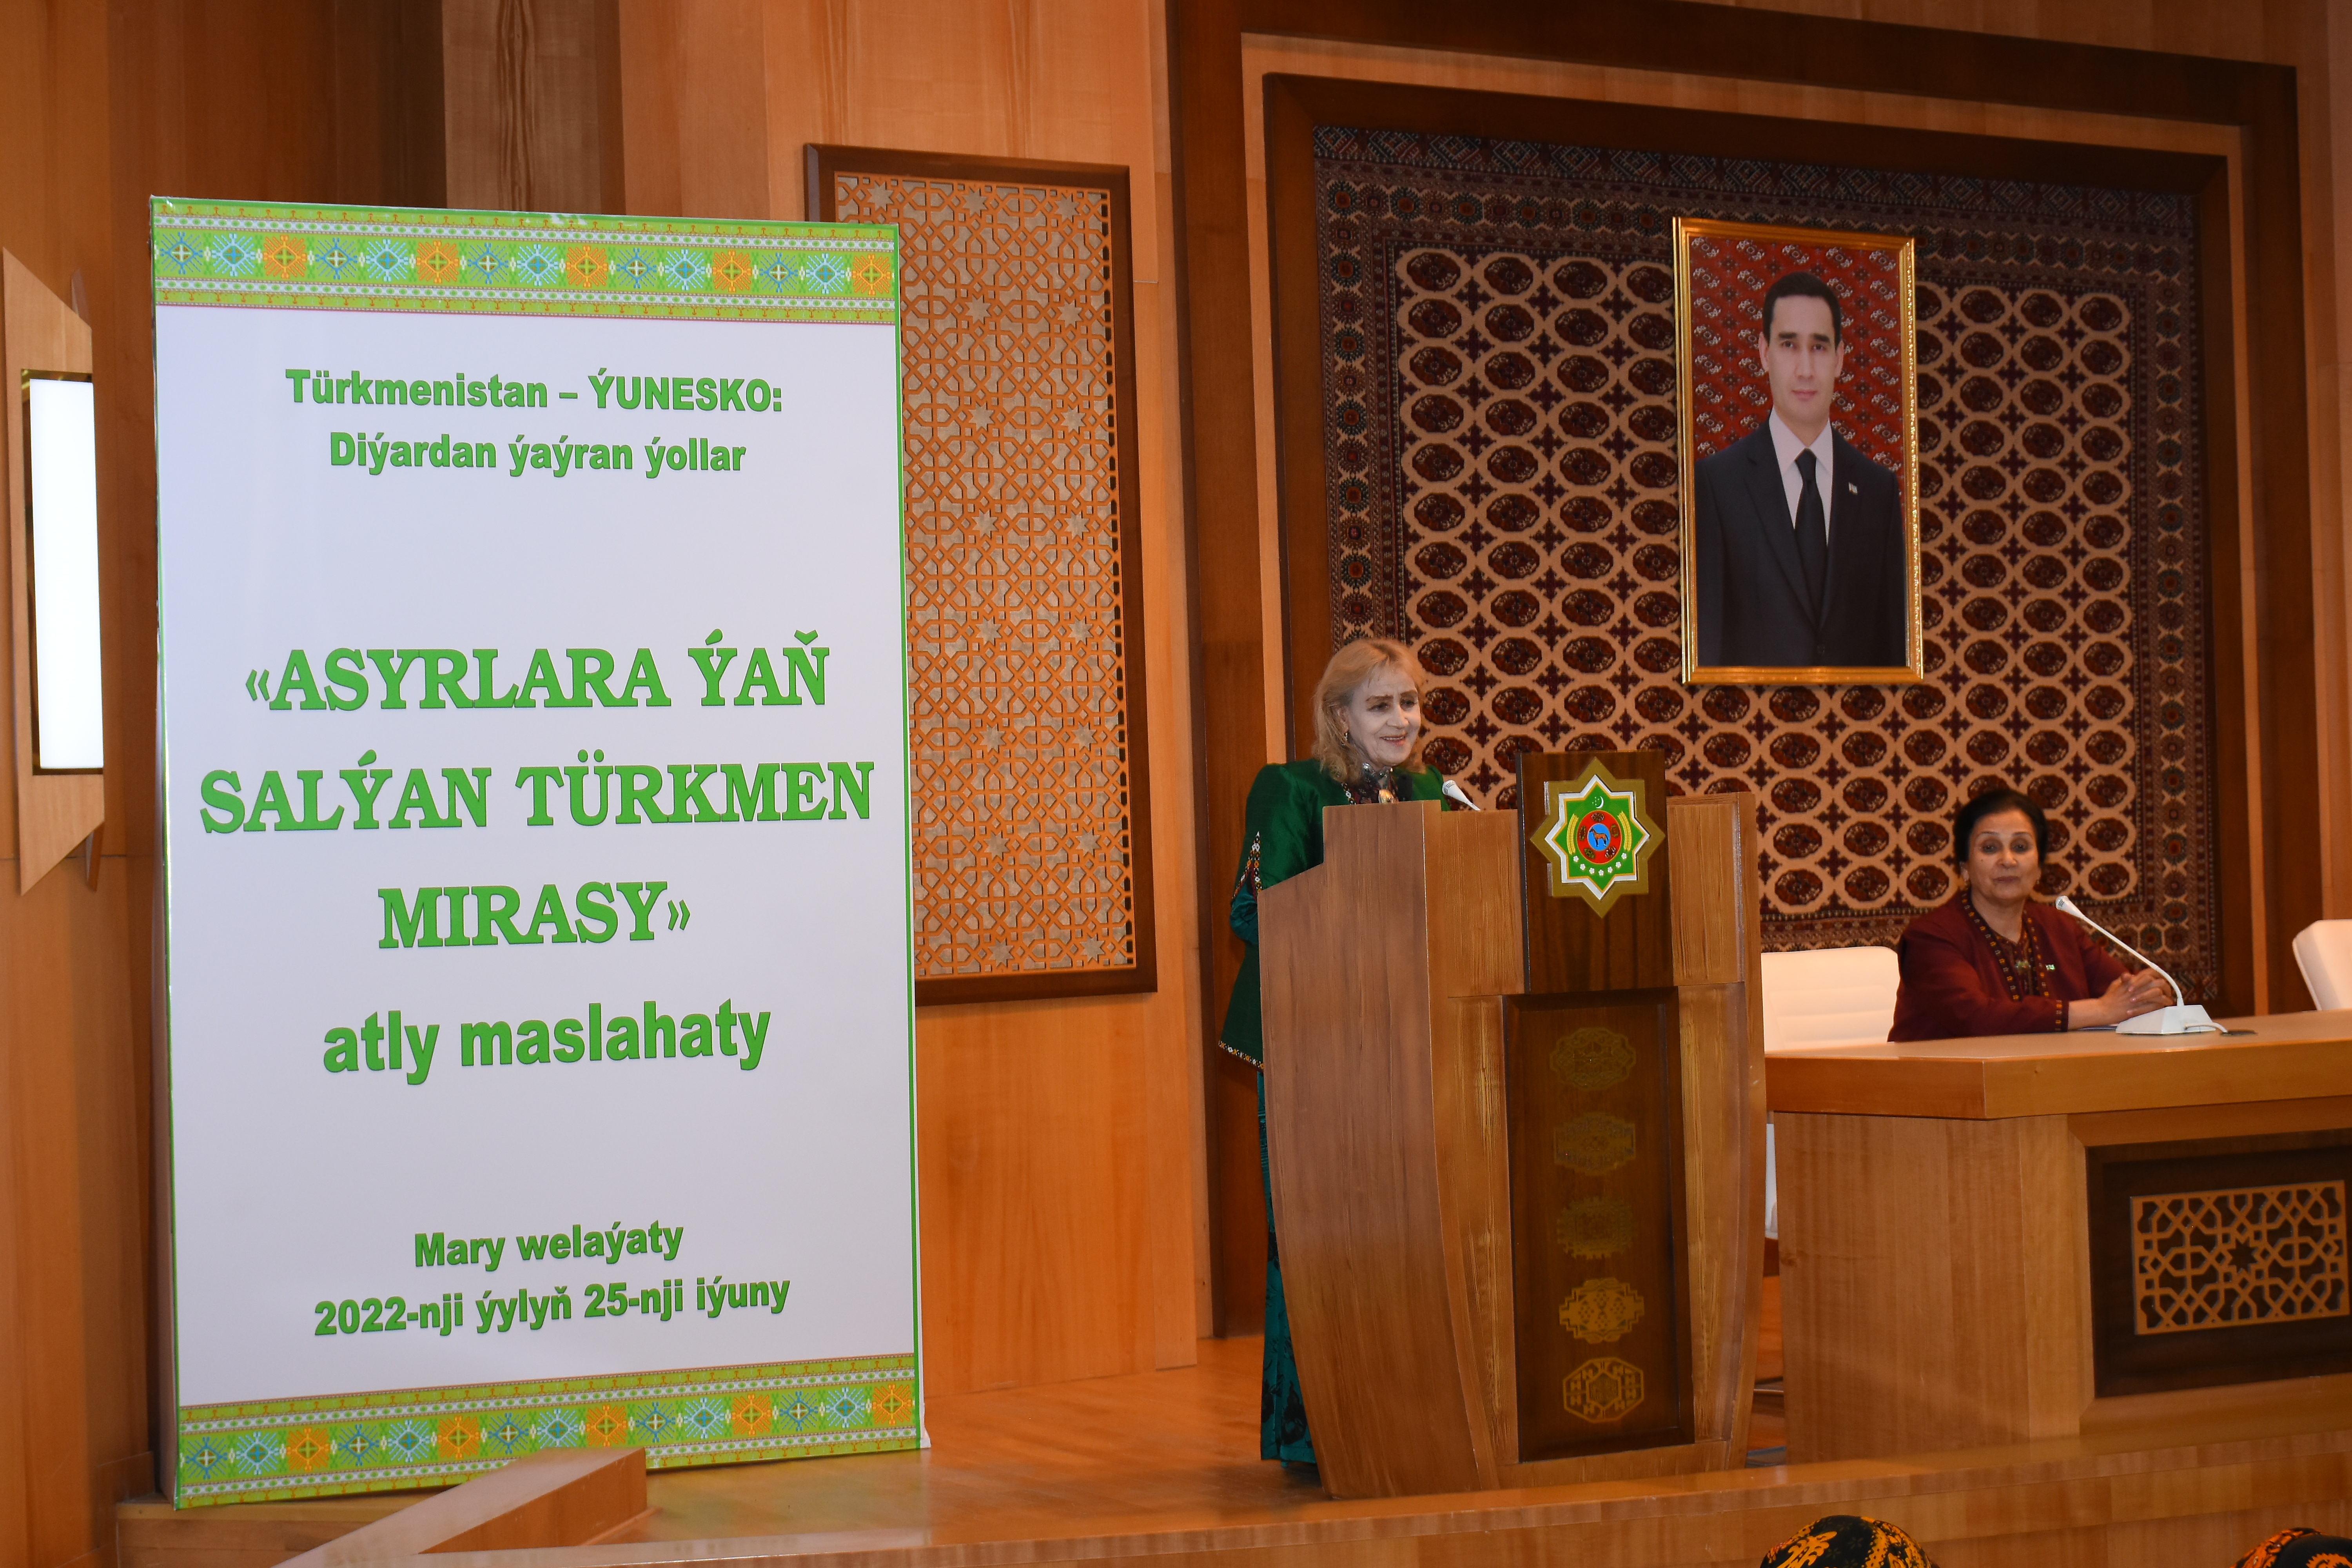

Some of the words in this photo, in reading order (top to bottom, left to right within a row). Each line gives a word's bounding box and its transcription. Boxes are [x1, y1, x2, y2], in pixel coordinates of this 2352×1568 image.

[285, 368, 548, 408] Türkmenistan
[588, 367, 782, 412] ÝUNESKO:
[331, 432, 497, 475] Diýardan
[509, 434, 634, 477] ýaýran
[645, 436, 747, 479] ýollar
[246, 647, 673, 711] «ASYRLARA
[688, 628, 831, 706] ÝAŇ
[200, 749, 493, 834] SALÝAN
[515, 749, 875, 826] TÜRKMEN
[378, 880, 691, 949] MIRASY»
[324, 1010, 440, 1085] atly
[461, 998, 771, 1071] maslahaty
[415, 1232, 506, 1272] Mary
[516, 1220, 684, 1265] welaýaty
[315, 1292, 464, 1336] 2022-nji
[476, 1285, 572, 1334] ýylyň
[584, 1278, 684, 1321] 25-nji
[697, 1275, 791, 1318] iýuny
